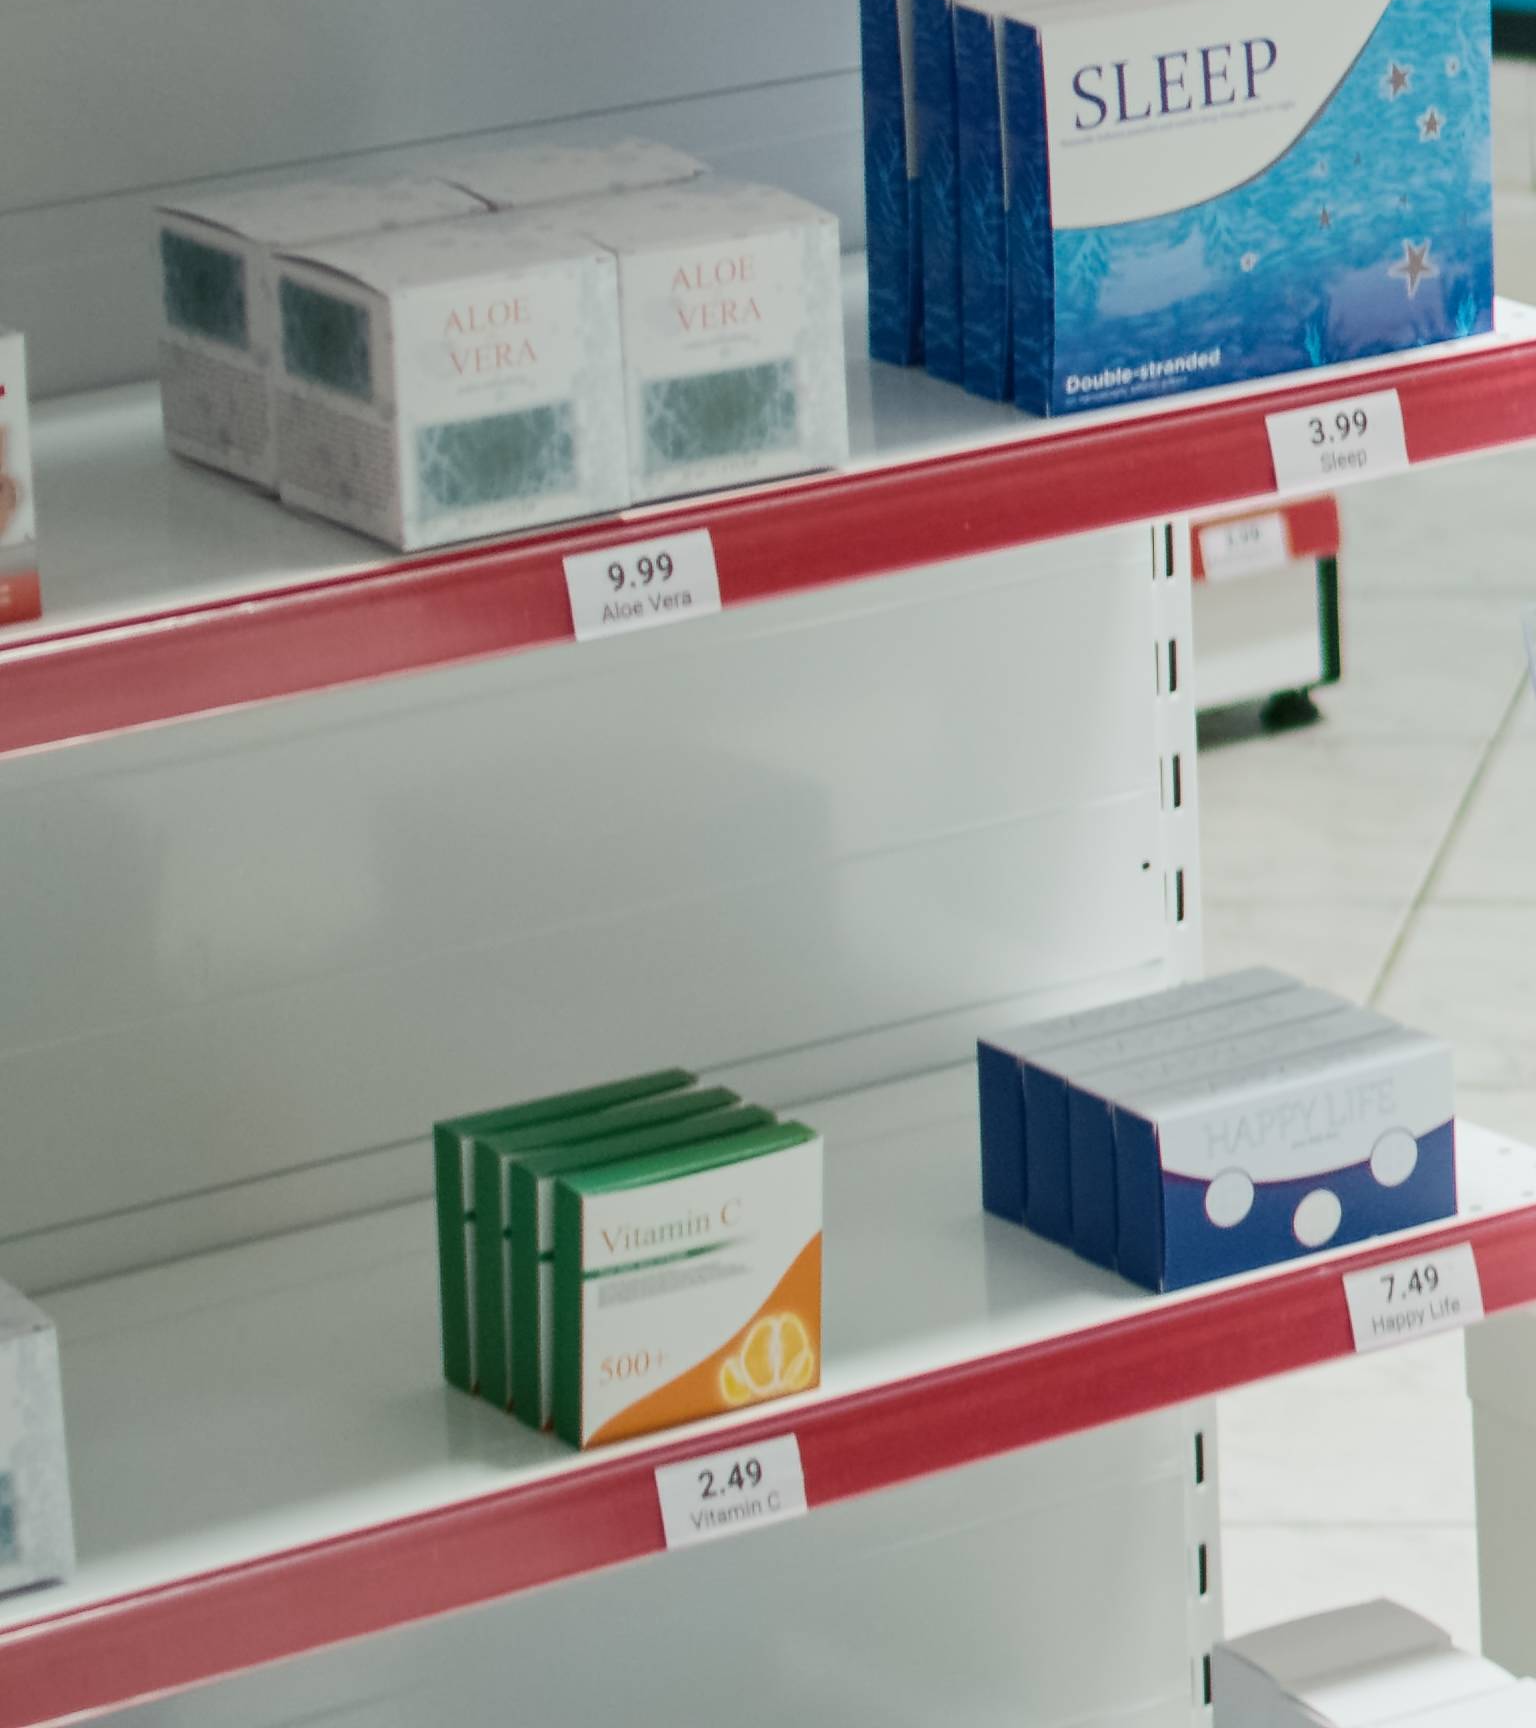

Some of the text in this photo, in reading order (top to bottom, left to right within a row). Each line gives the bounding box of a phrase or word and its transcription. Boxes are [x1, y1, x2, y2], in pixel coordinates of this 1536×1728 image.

[1071, 35, 1280, 132] SLEEP
[671, 255, 757, 291] ALOE
[443, 296, 532, 334] ALOE
[675, 296, 764, 333] VERA
[449, 339, 539, 376] VERA
[1064, 347, 1222, 395] Double-stranded
[1309, 410, 1369, 446] 3.99
[1320, 445, 1368, 474] Sleep
[607, 552, 675, 592] 9.99
[602, 587, 693, 624] Aloe Vera
[1203, 1077, 1398, 1158] HAPPY LIFE
[601, 1198, 742, 1255] Vitamin C
[1379, 1266, 1440, 1303] 7.49
[1371, 1296, 1461, 1336] Happy Life
[699, 1458, 763, 1499] 2.49
[689, 1491, 782, 1532] Vitamin C
